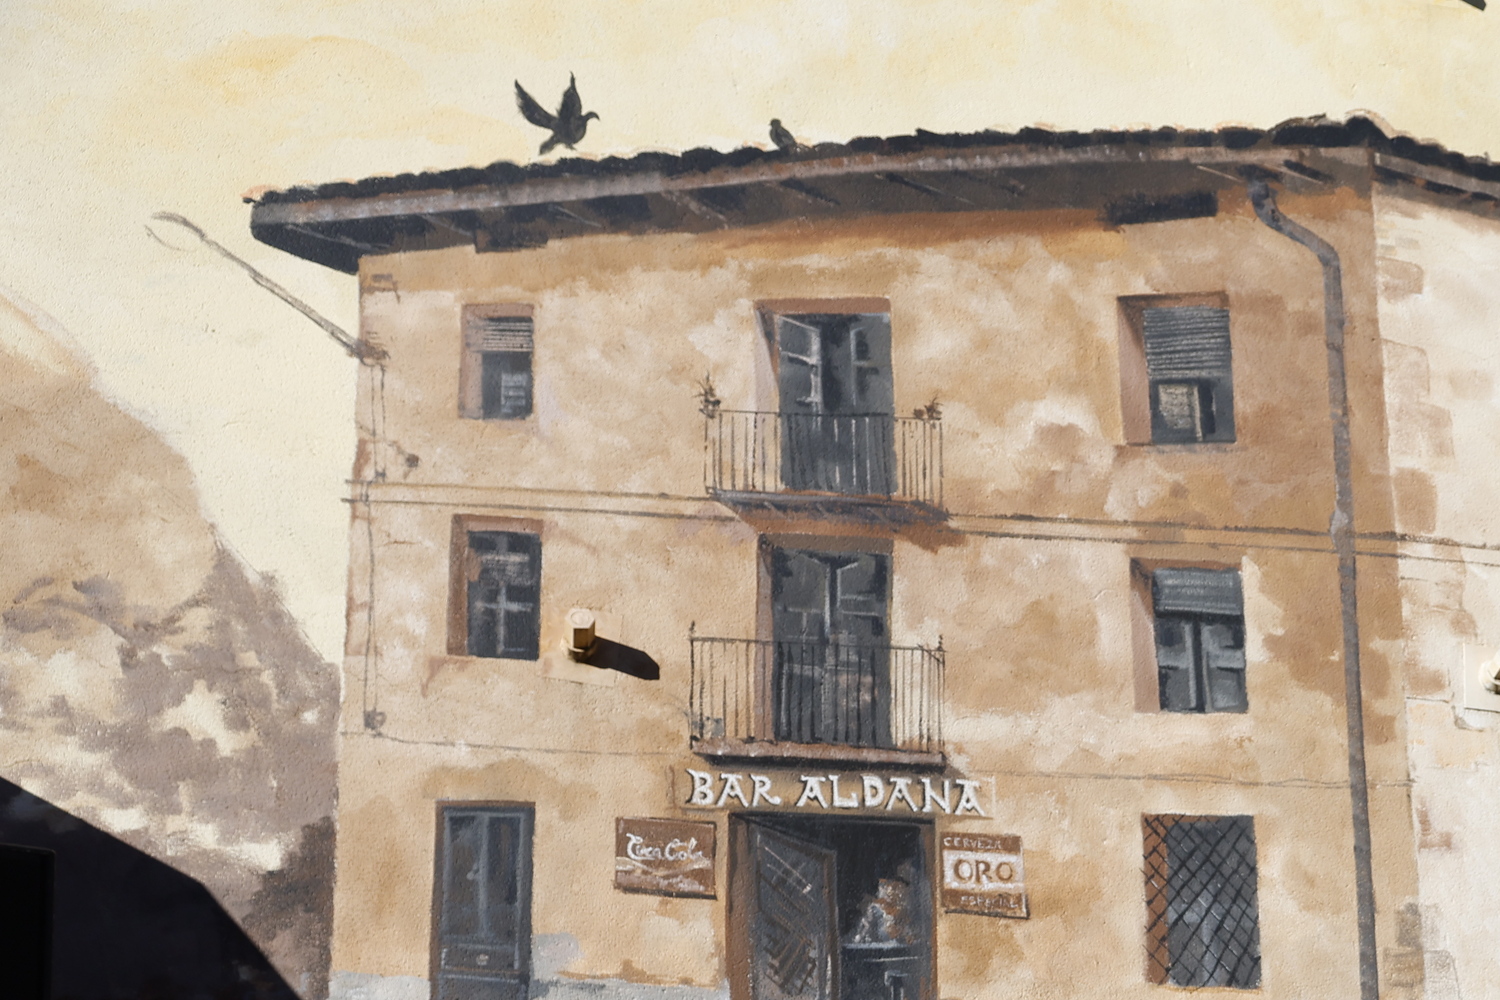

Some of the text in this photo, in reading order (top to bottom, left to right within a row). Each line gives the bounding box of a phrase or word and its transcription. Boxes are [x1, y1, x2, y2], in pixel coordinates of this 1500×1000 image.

[686, 768, 986, 817] BAR ALDANA
[943, 836, 1003, 850] CERVEZA
[953, 858, 1013, 884] ORO
